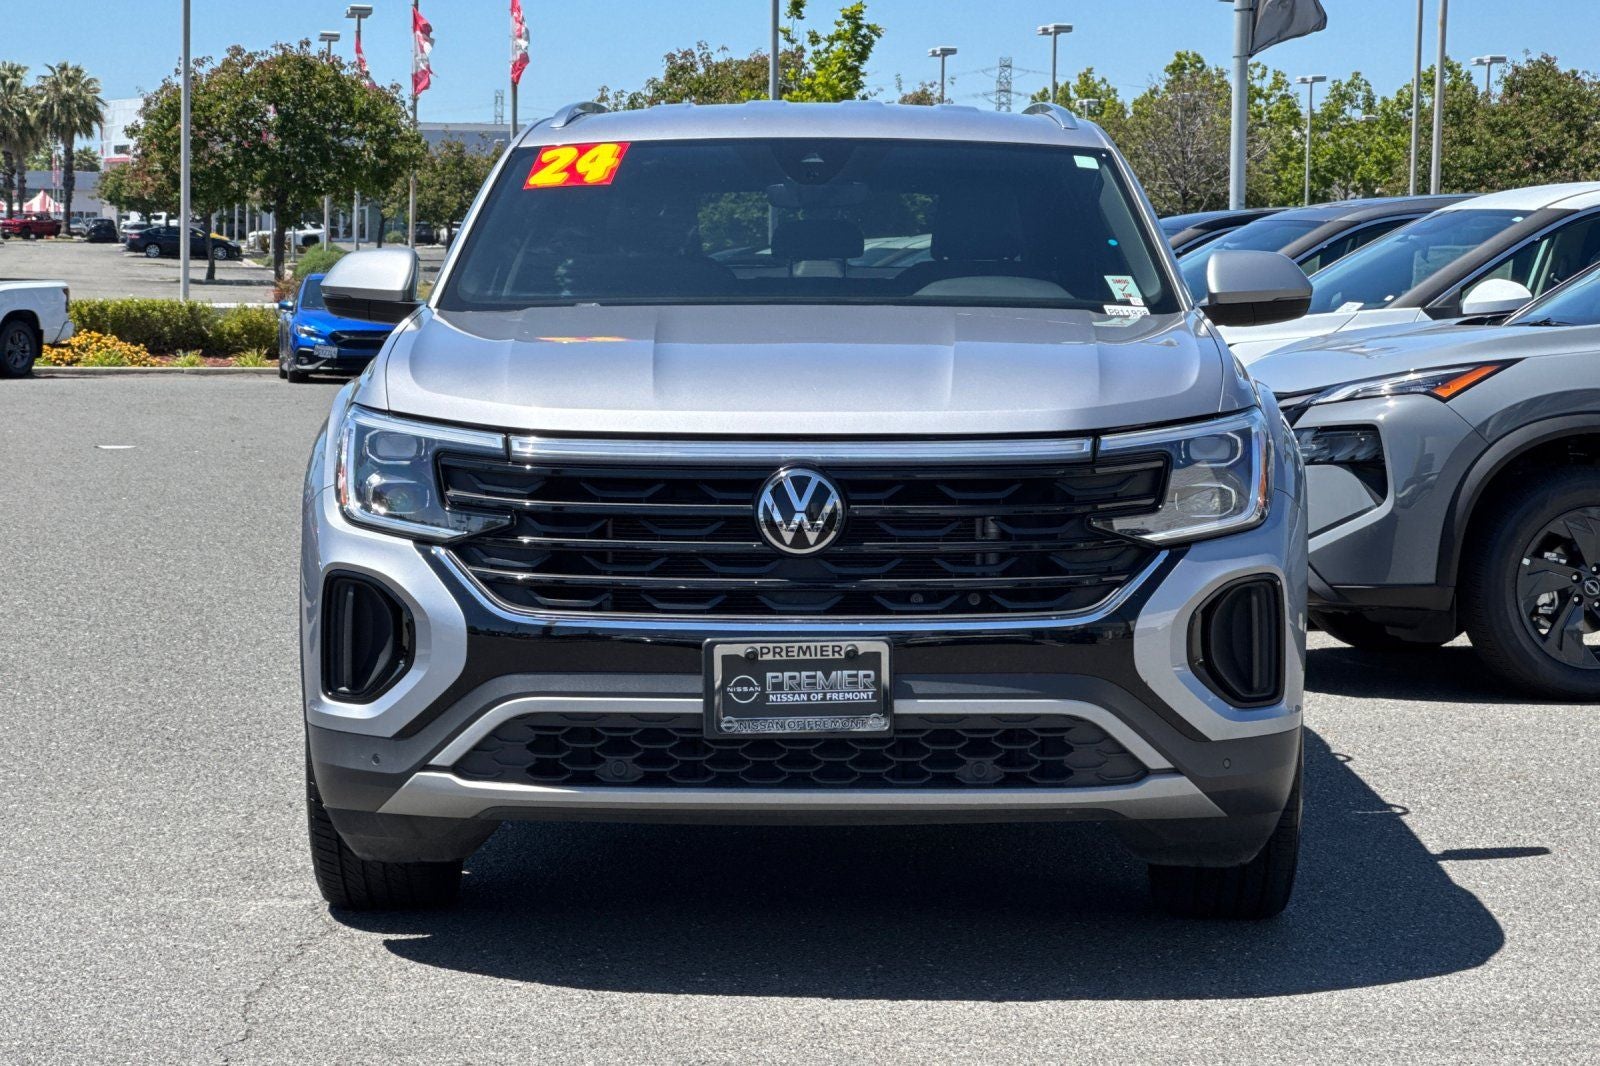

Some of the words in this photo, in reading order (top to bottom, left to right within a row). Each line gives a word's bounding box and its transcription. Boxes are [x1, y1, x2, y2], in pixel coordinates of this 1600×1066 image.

[528, 144, 621, 187] 24
[759, 645, 843, 658] PREMIER
[765, 670, 876, 691] PREMIER
[769, 693, 808, 702] NISSAN
[810, 693, 824, 701] OF
[826, 691, 874, 700] FREMONT
[738, 719, 785, 731] NISSAN
[787, 719, 804, 730] OF
[806, 718, 866, 730] FREMONT
